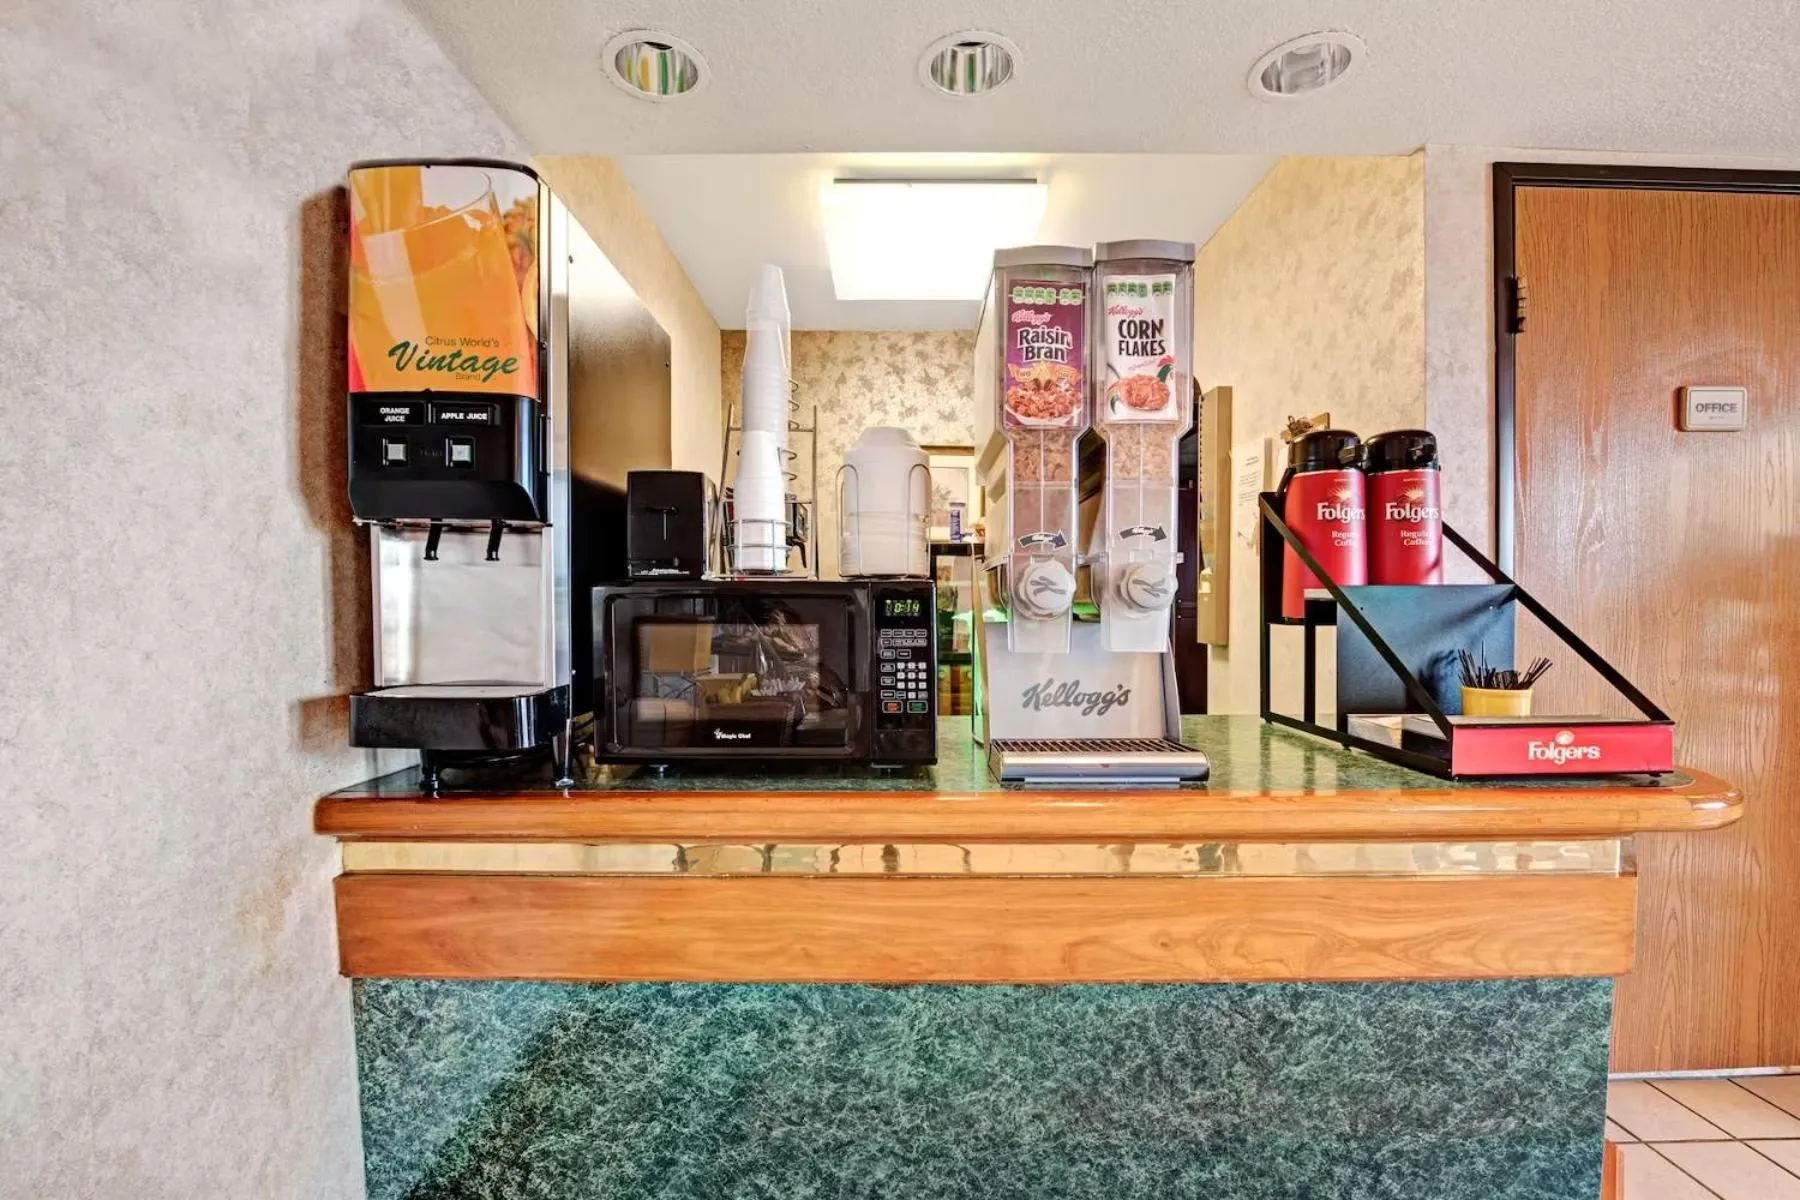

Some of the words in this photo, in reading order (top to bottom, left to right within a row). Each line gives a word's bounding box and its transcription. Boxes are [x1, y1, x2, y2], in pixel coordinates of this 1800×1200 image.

[1019, 327, 1071, 347] Raisin
[1118, 318, 1164, 339] CORN
[425, 335, 457, 346] Citrus
[460, 337, 500, 348] World's
[1119, 339, 1166, 356] FLAKES
[388, 340, 519, 383] Vintage
[1025, 345, 1065, 361] Bran
[455, 371, 481, 381] Brand
[380, 407, 410, 415] ORANGE
[441, 412, 465, 420] APPLE
[1696, 403, 1738, 413] OFFICE
[1317, 502, 1366, 524] Folgers
[1385, 502, 1440, 523] Folgers
[1022, 678, 1132, 717] Kellogg's
[1528, 740, 1601, 766] Folgers
